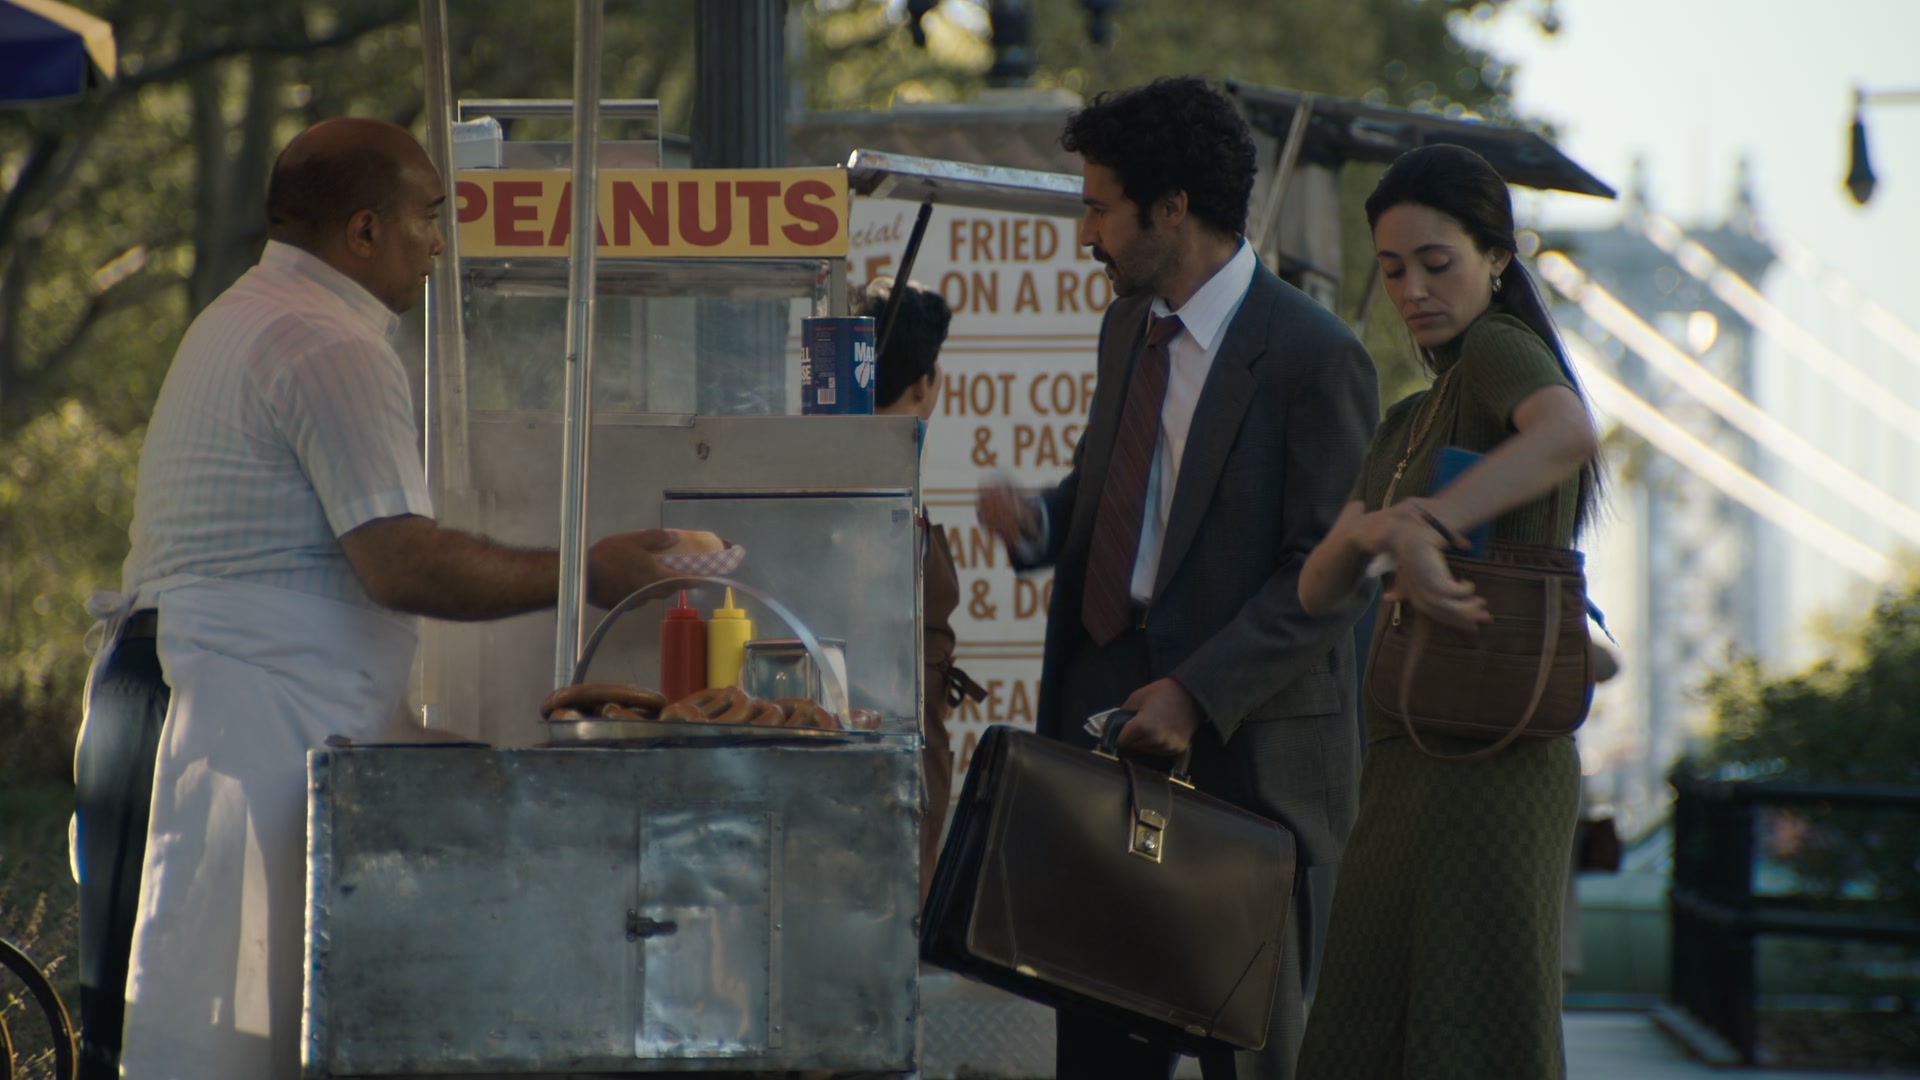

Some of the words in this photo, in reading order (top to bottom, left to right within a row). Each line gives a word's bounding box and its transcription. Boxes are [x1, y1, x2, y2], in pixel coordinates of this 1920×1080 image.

[455, 180, 839, 247] PEANUTS
[951, 218, 1058, 263] FRIED
[940, 270, 998, 315] ON
[1013, 270, 1041, 314] A
[943, 372, 1016, 417] HOT
[971, 425, 998, 468] &
[1013, 423, 1088, 468] PAS
[968, 578, 997, 621] &
